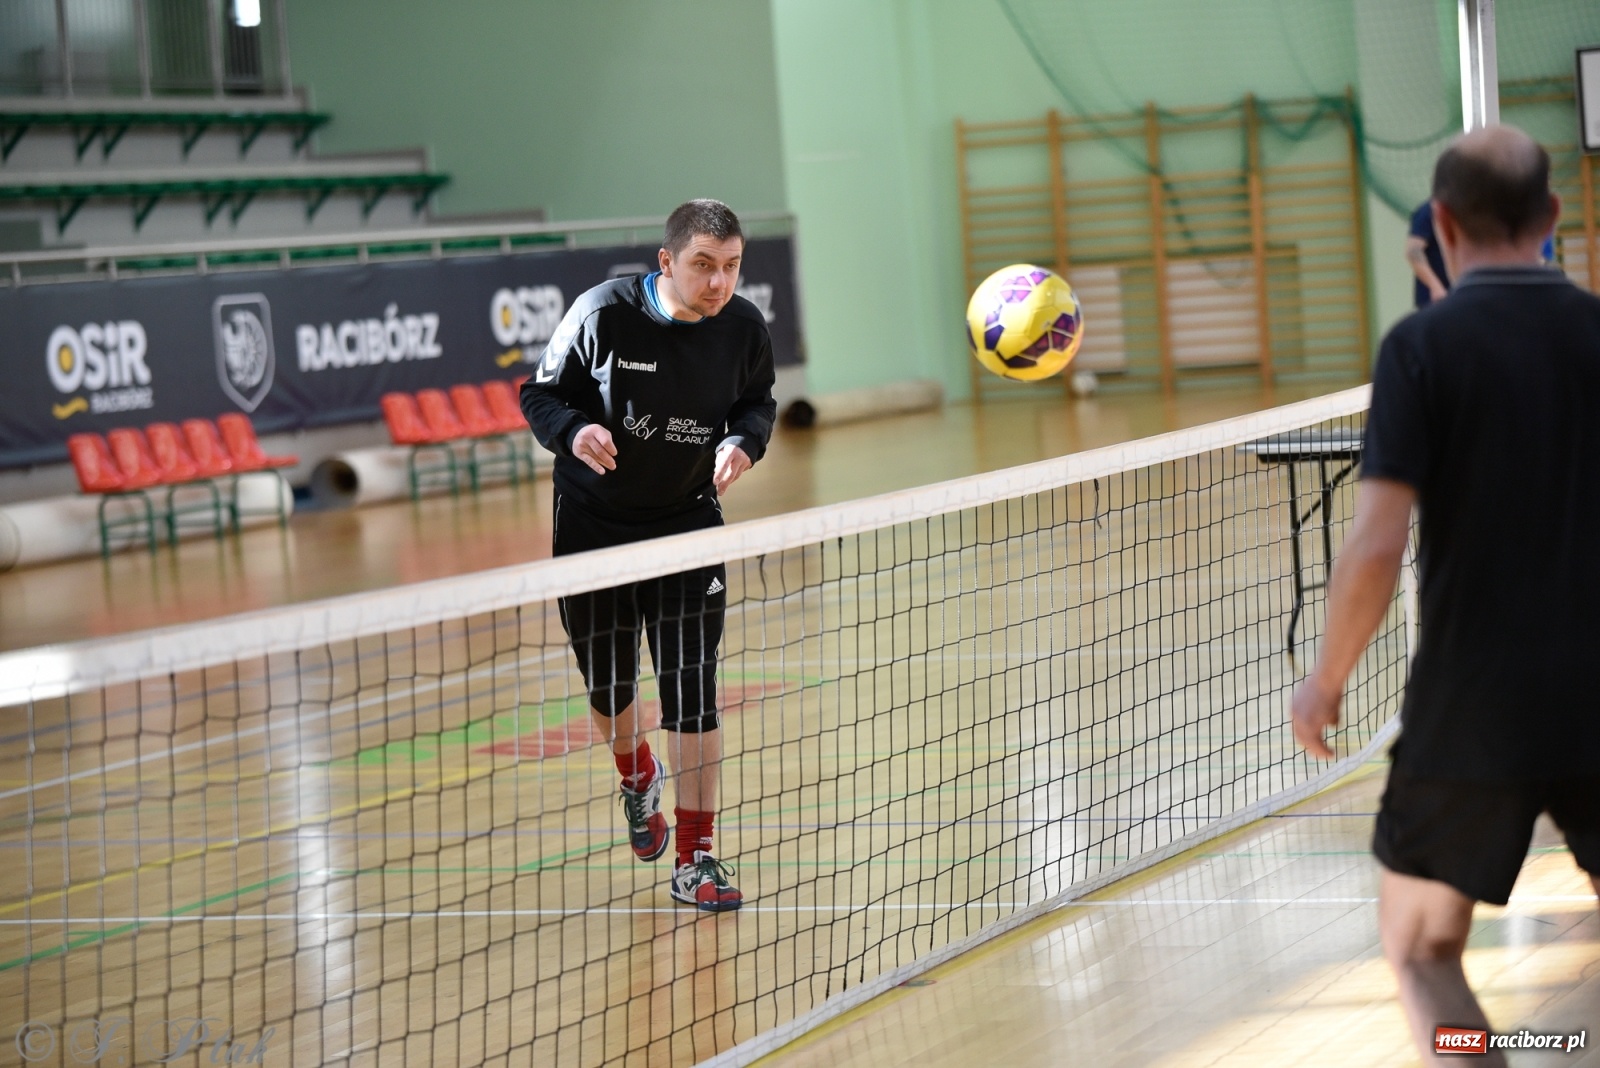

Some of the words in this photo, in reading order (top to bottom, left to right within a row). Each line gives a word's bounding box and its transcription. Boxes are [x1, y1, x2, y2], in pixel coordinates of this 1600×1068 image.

[296, 303, 442, 372] RACIBÓRZ
[618, 357, 657, 372] hummel
[668, 417, 697, 427] SALON
